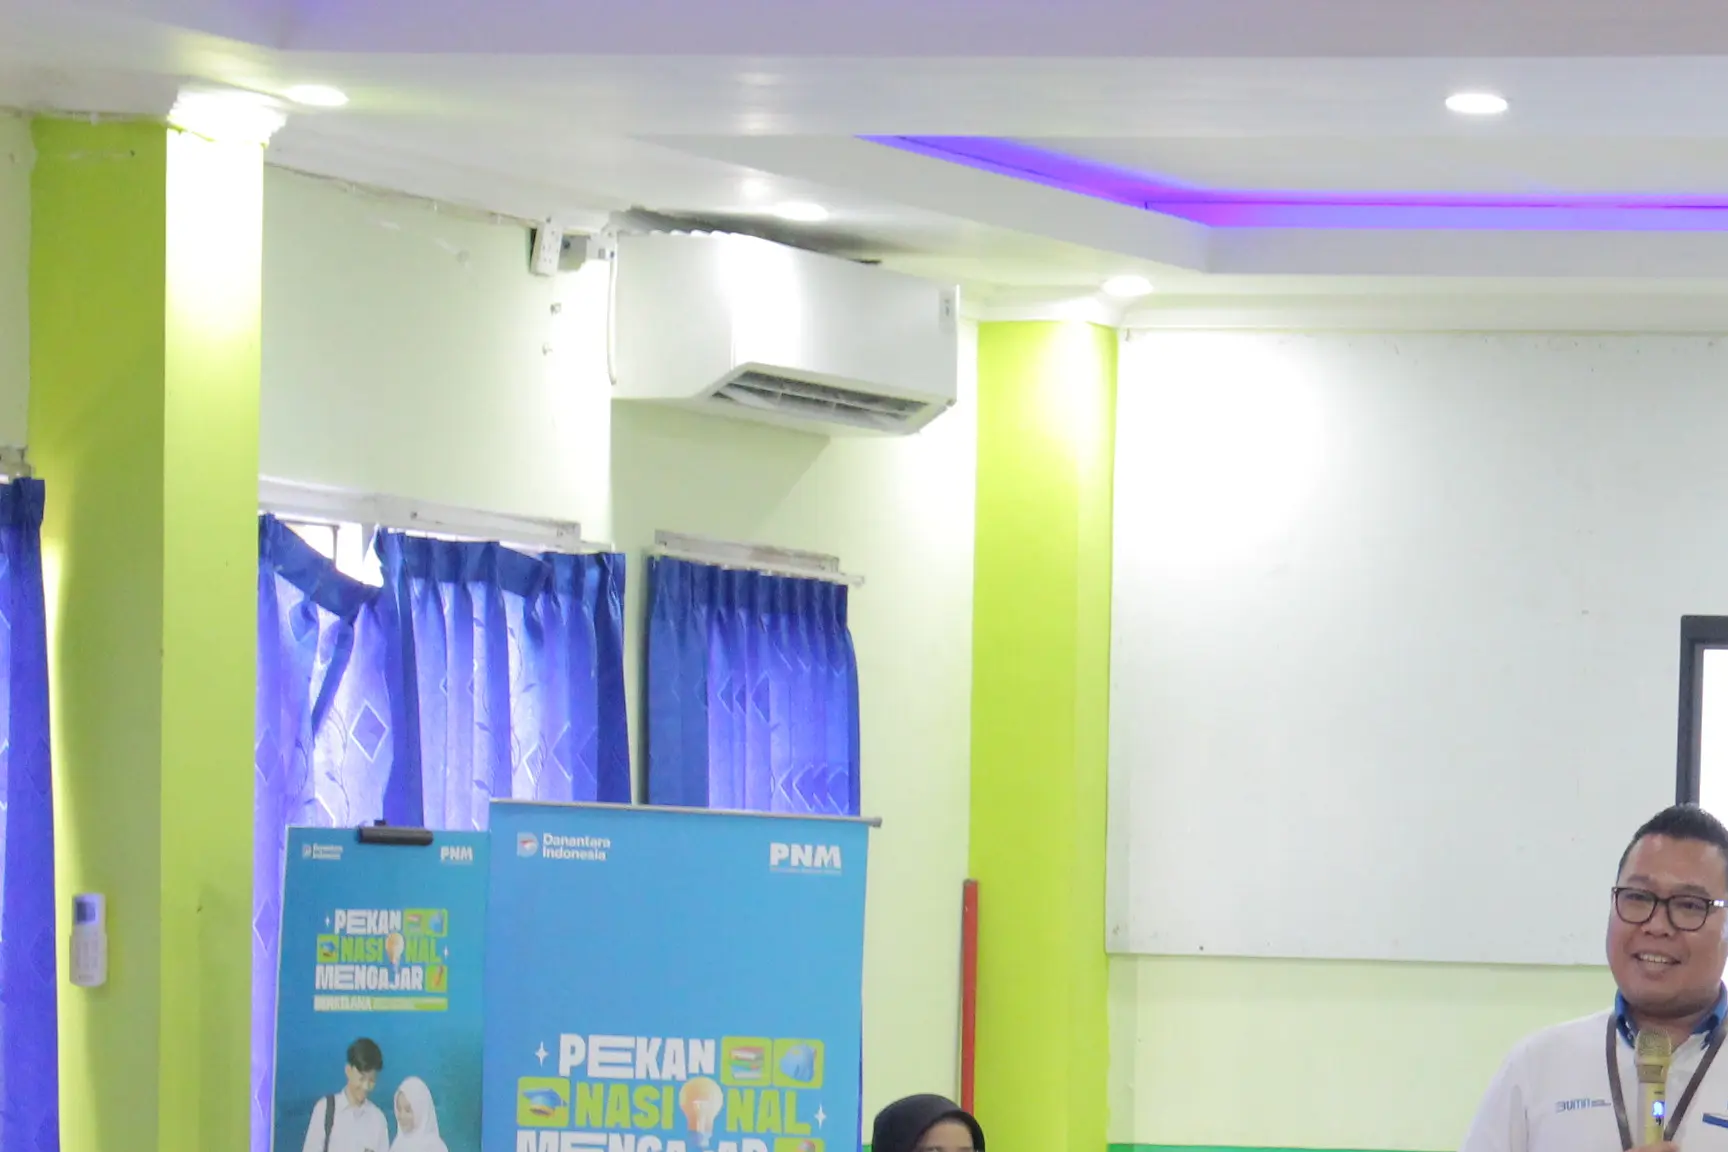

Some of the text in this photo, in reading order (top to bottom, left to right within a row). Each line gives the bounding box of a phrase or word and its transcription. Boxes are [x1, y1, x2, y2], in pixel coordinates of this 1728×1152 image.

[441, 846, 473, 861] PNM
[543, 833, 611, 849] Danantara
[543, 847, 606, 861] Indonesia
[770, 843, 842, 869] PNM
[334, 909, 401, 935] PEKAN
[315, 964, 424, 991] MENGAJAR
[559, 1033, 716, 1081] PEKAN
